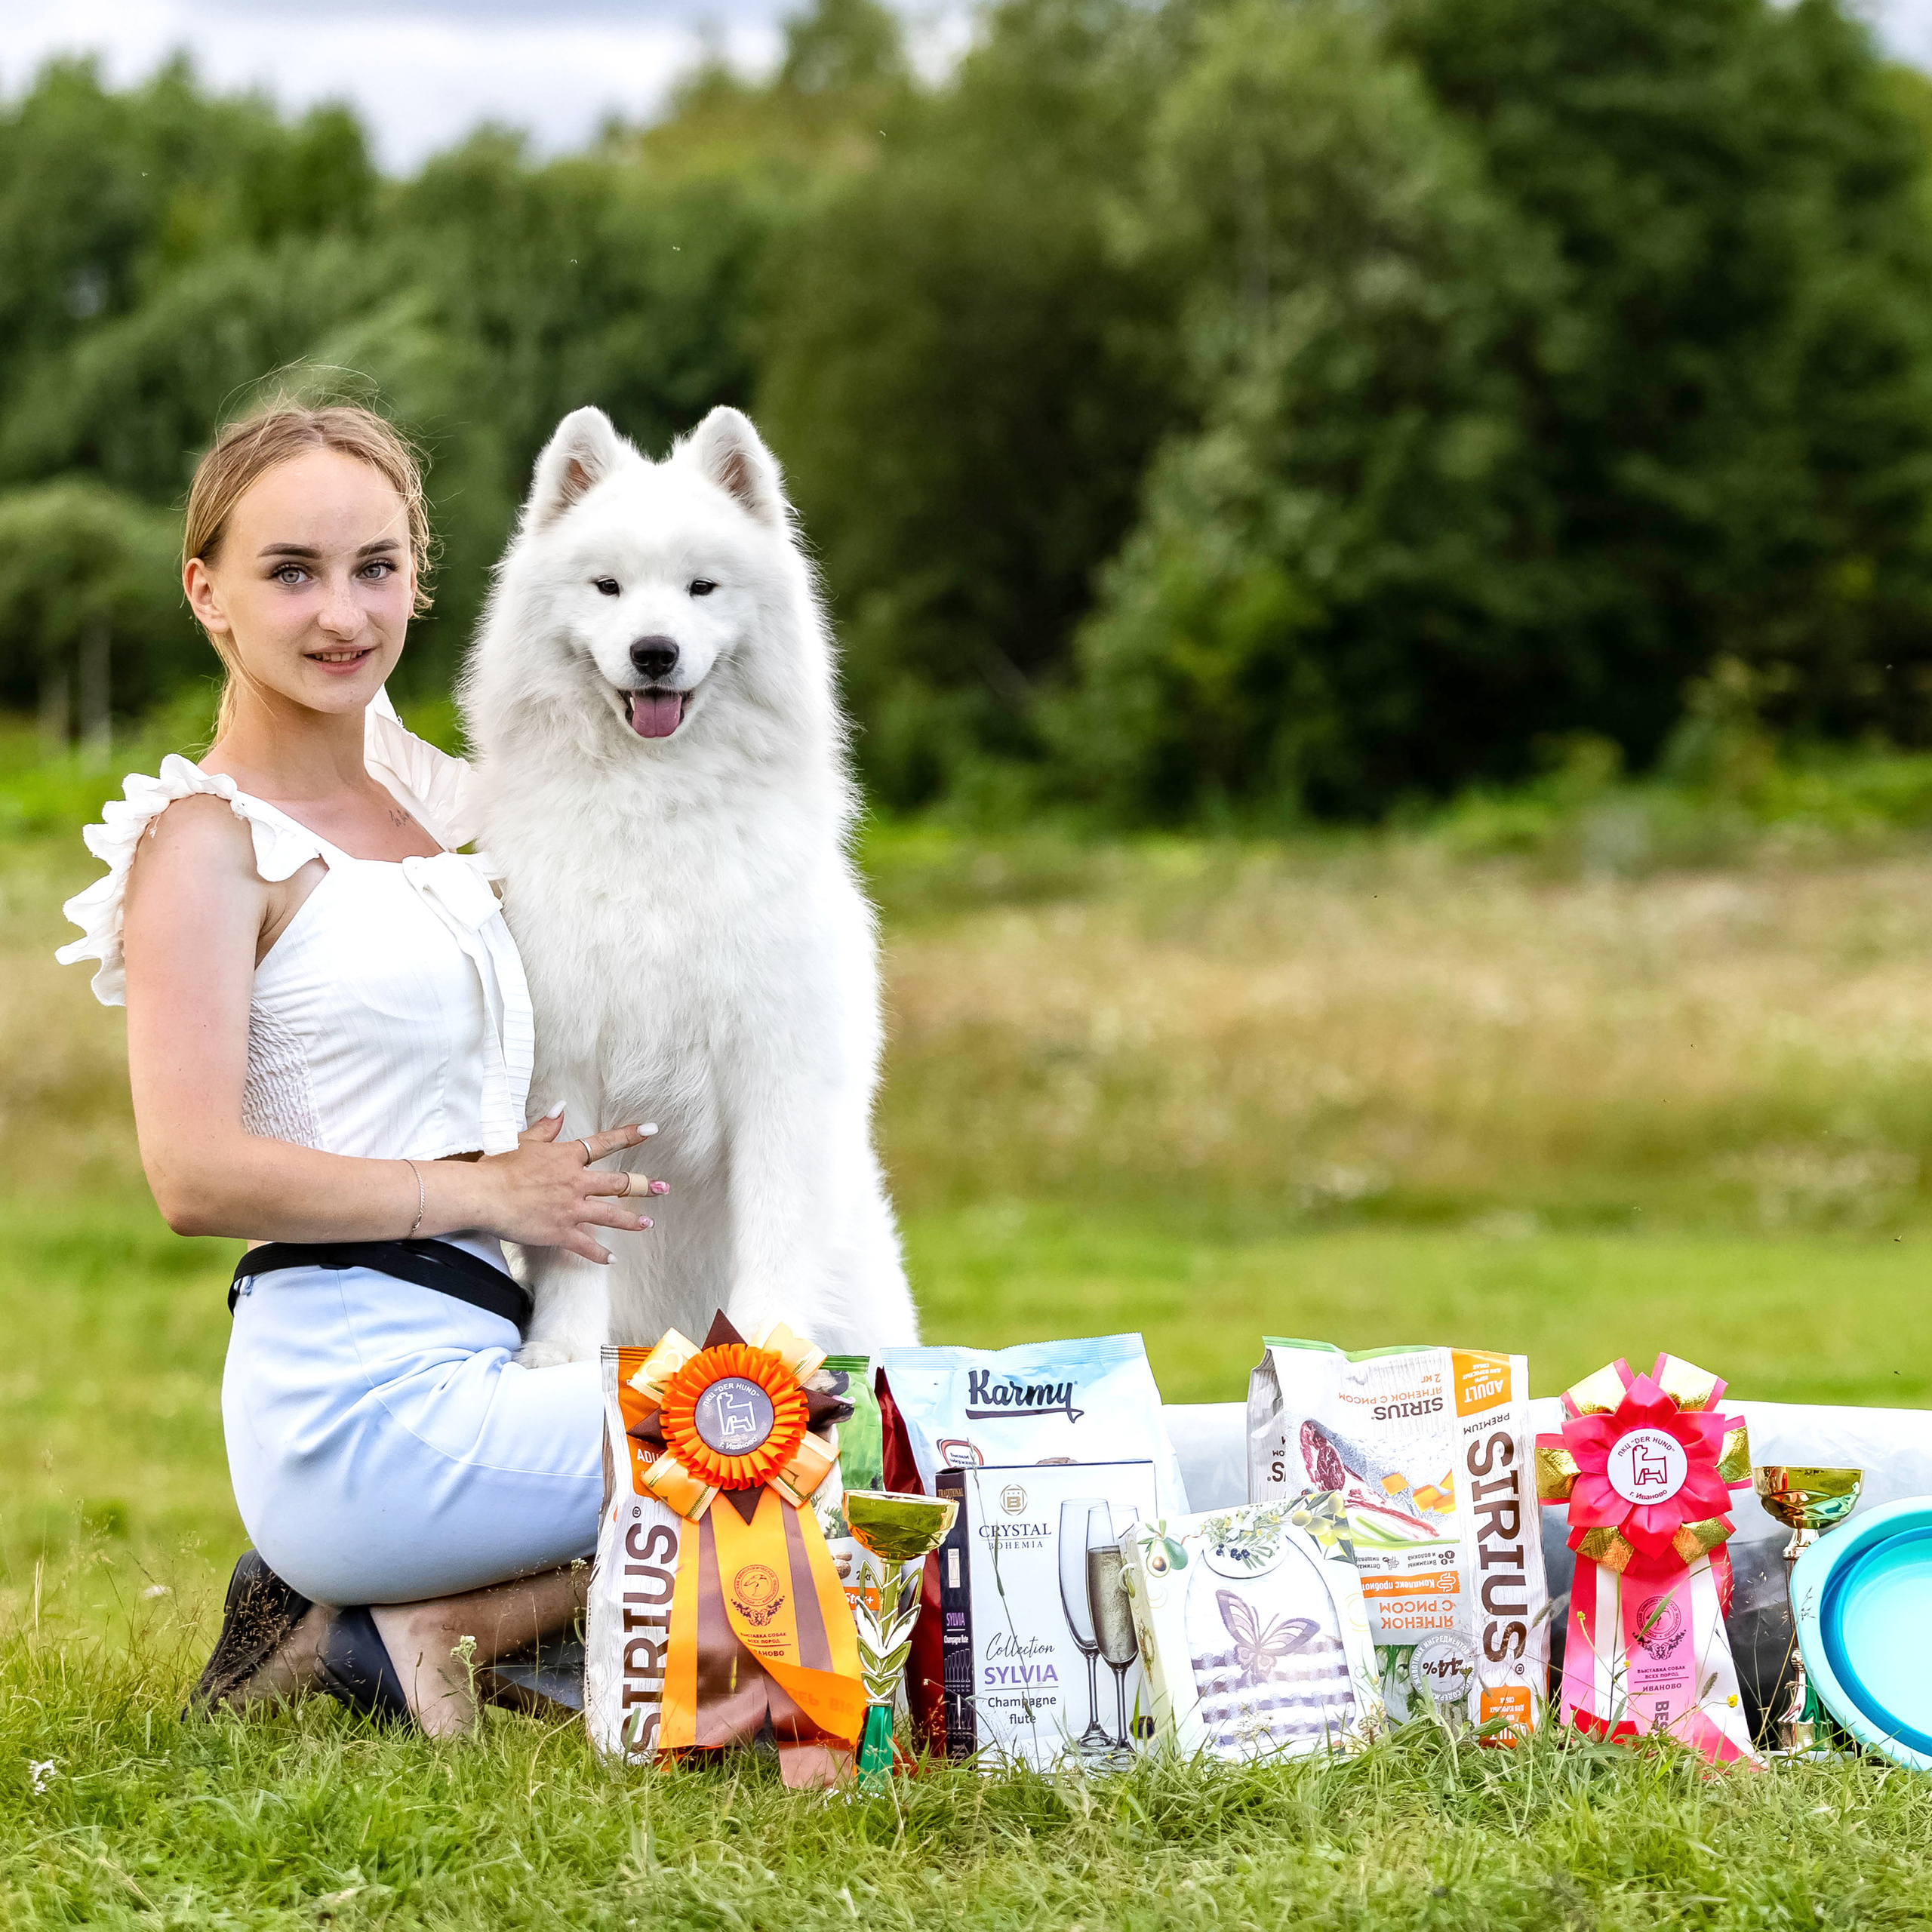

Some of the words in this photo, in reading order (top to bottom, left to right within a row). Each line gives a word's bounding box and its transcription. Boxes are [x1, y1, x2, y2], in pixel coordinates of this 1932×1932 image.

[1421, 1375, 1432, 1383] кг
[1435, 1374, 1441, 1383] 2
[967, 1369, 1079, 1423] Karmy
[1338, 1392, 1377, 1404] РИСОМ
[1391, 1386, 1442, 1401] ЯГНЕНОК
[1464, 1380, 1504, 1403] ADULT
[703, 1392, 716, 1407] ПКЦ
[1380, 1395, 1388, 1404] С
[1374, 1397, 1444, 1420] SIRIUS
[1463, 1413, 1510, 1435] PREMIUM
[726, 1437, 757, 1450] Иваново
[1617, 1443, 1632, 1457] ПКЦ
[637, 1448, 659, 1463] ADU
[1635, 1490, 1668, 1500] Иваново
[979, 1523, 1052, 1537] CRYSTAL
[989, 1541, 1043, 1550] BOHEMIA
[1467, 1432, 1528, 1663] SIRIUS
[1407, 1559, 1437, 1568] Витамины
[1361, 1580, 1394, 1592] пробиот
[1395, 1579, 1435, 1589] Комплекс
[1379, 1600, 1437, 1614] РИСОМ
[1441, 1600, 1454, 1612] С
[946, 1612, 965, 1626] SYLVIA
[1381, 1616, 1454, 1629] ЯГНЕНОК
[622, 1522, 678, 1754] SIRIUS
[986, 1632, 1055, 1660] Collection
[1410, 1644, 1423, 1685] ЖИВОТНЫХ
[1421, 1635, 1471, 1654] ИНГРЕДИЕНТОВ
[984, 1664, 1058, 1684] SYLVIA
[1643, 1683, 1681, 1691] ИВАНОВО
[988, 1697, 1057, 1709] Champagne
[1010, 1714, 1036, 1724] flute
